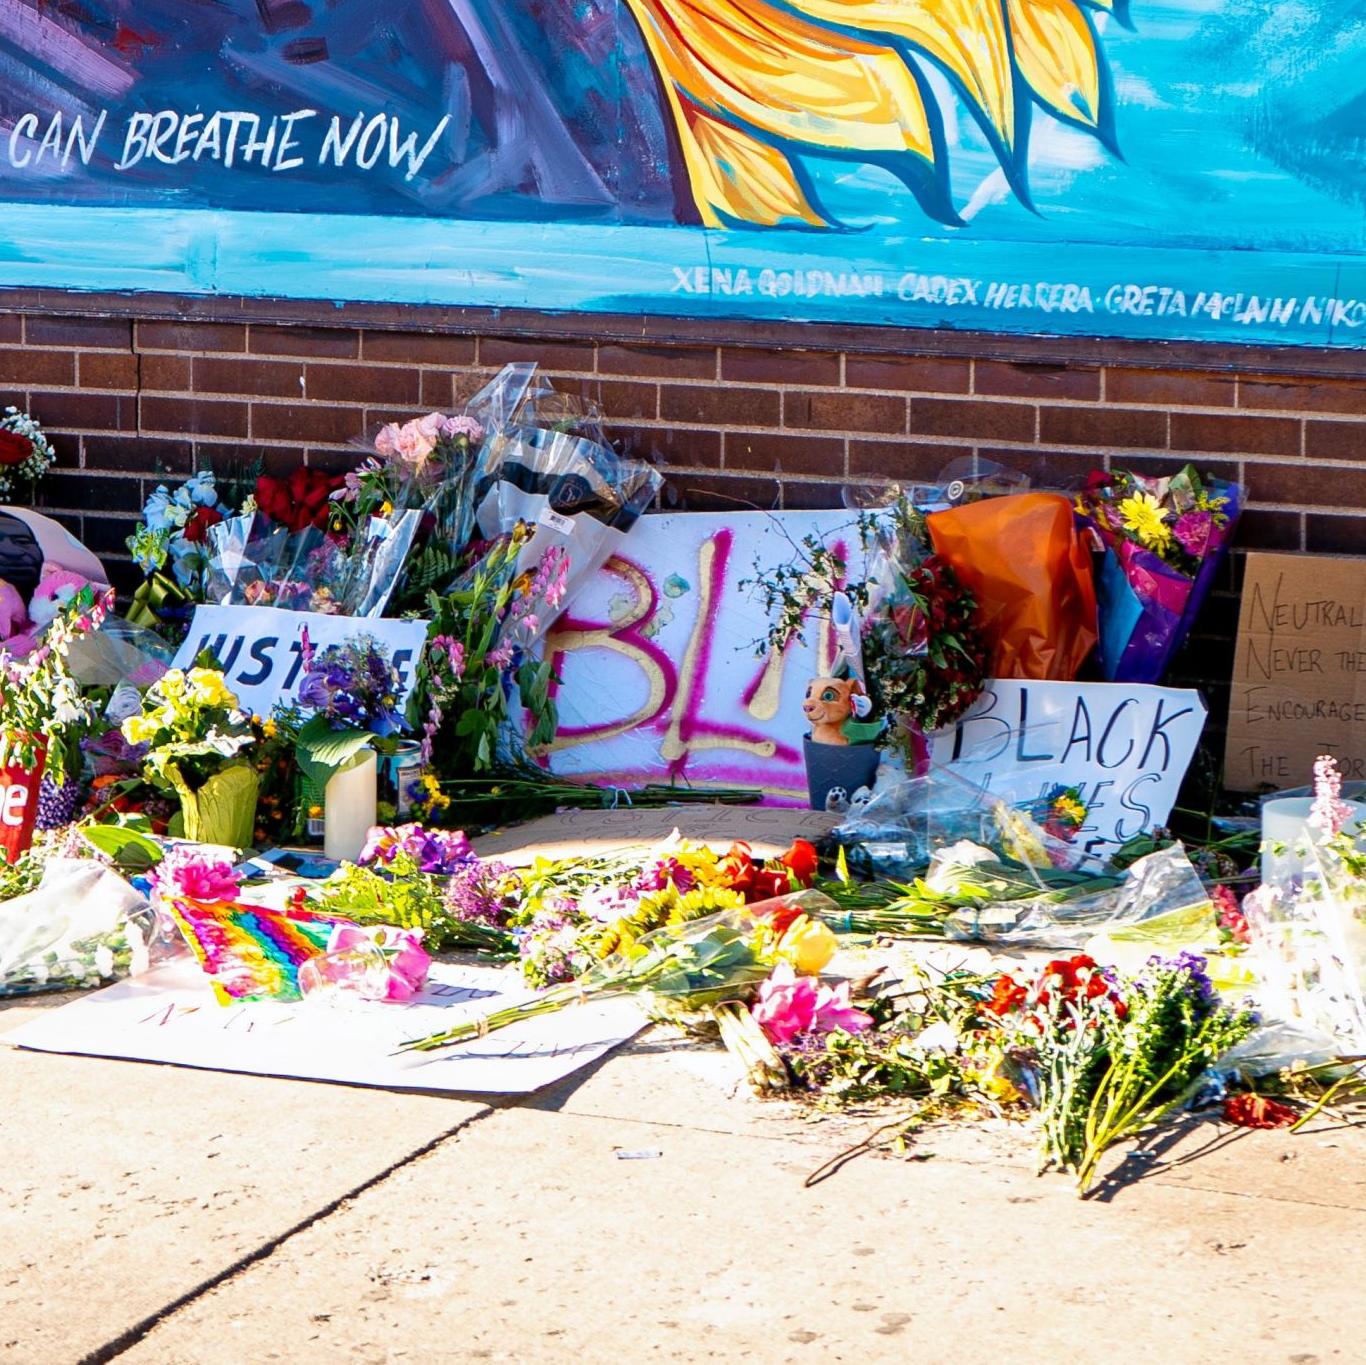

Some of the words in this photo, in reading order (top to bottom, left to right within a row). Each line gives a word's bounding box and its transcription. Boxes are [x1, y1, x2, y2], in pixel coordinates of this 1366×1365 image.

[9, 108, 107, 172] CAN
[113, 107, 317, 172] BREATHE
[319, 109, 453, 182] NOW
[669, 266, 754, 296] XENA
[898, 272, 982, 306] CADEX
[984, 282, 1094, 313] HERRERA
[1104, 284, 1187, 317] GRETA
[1246, 635, 1324, 680] NEVER
[951, 687, 1194, 772] BLACK
